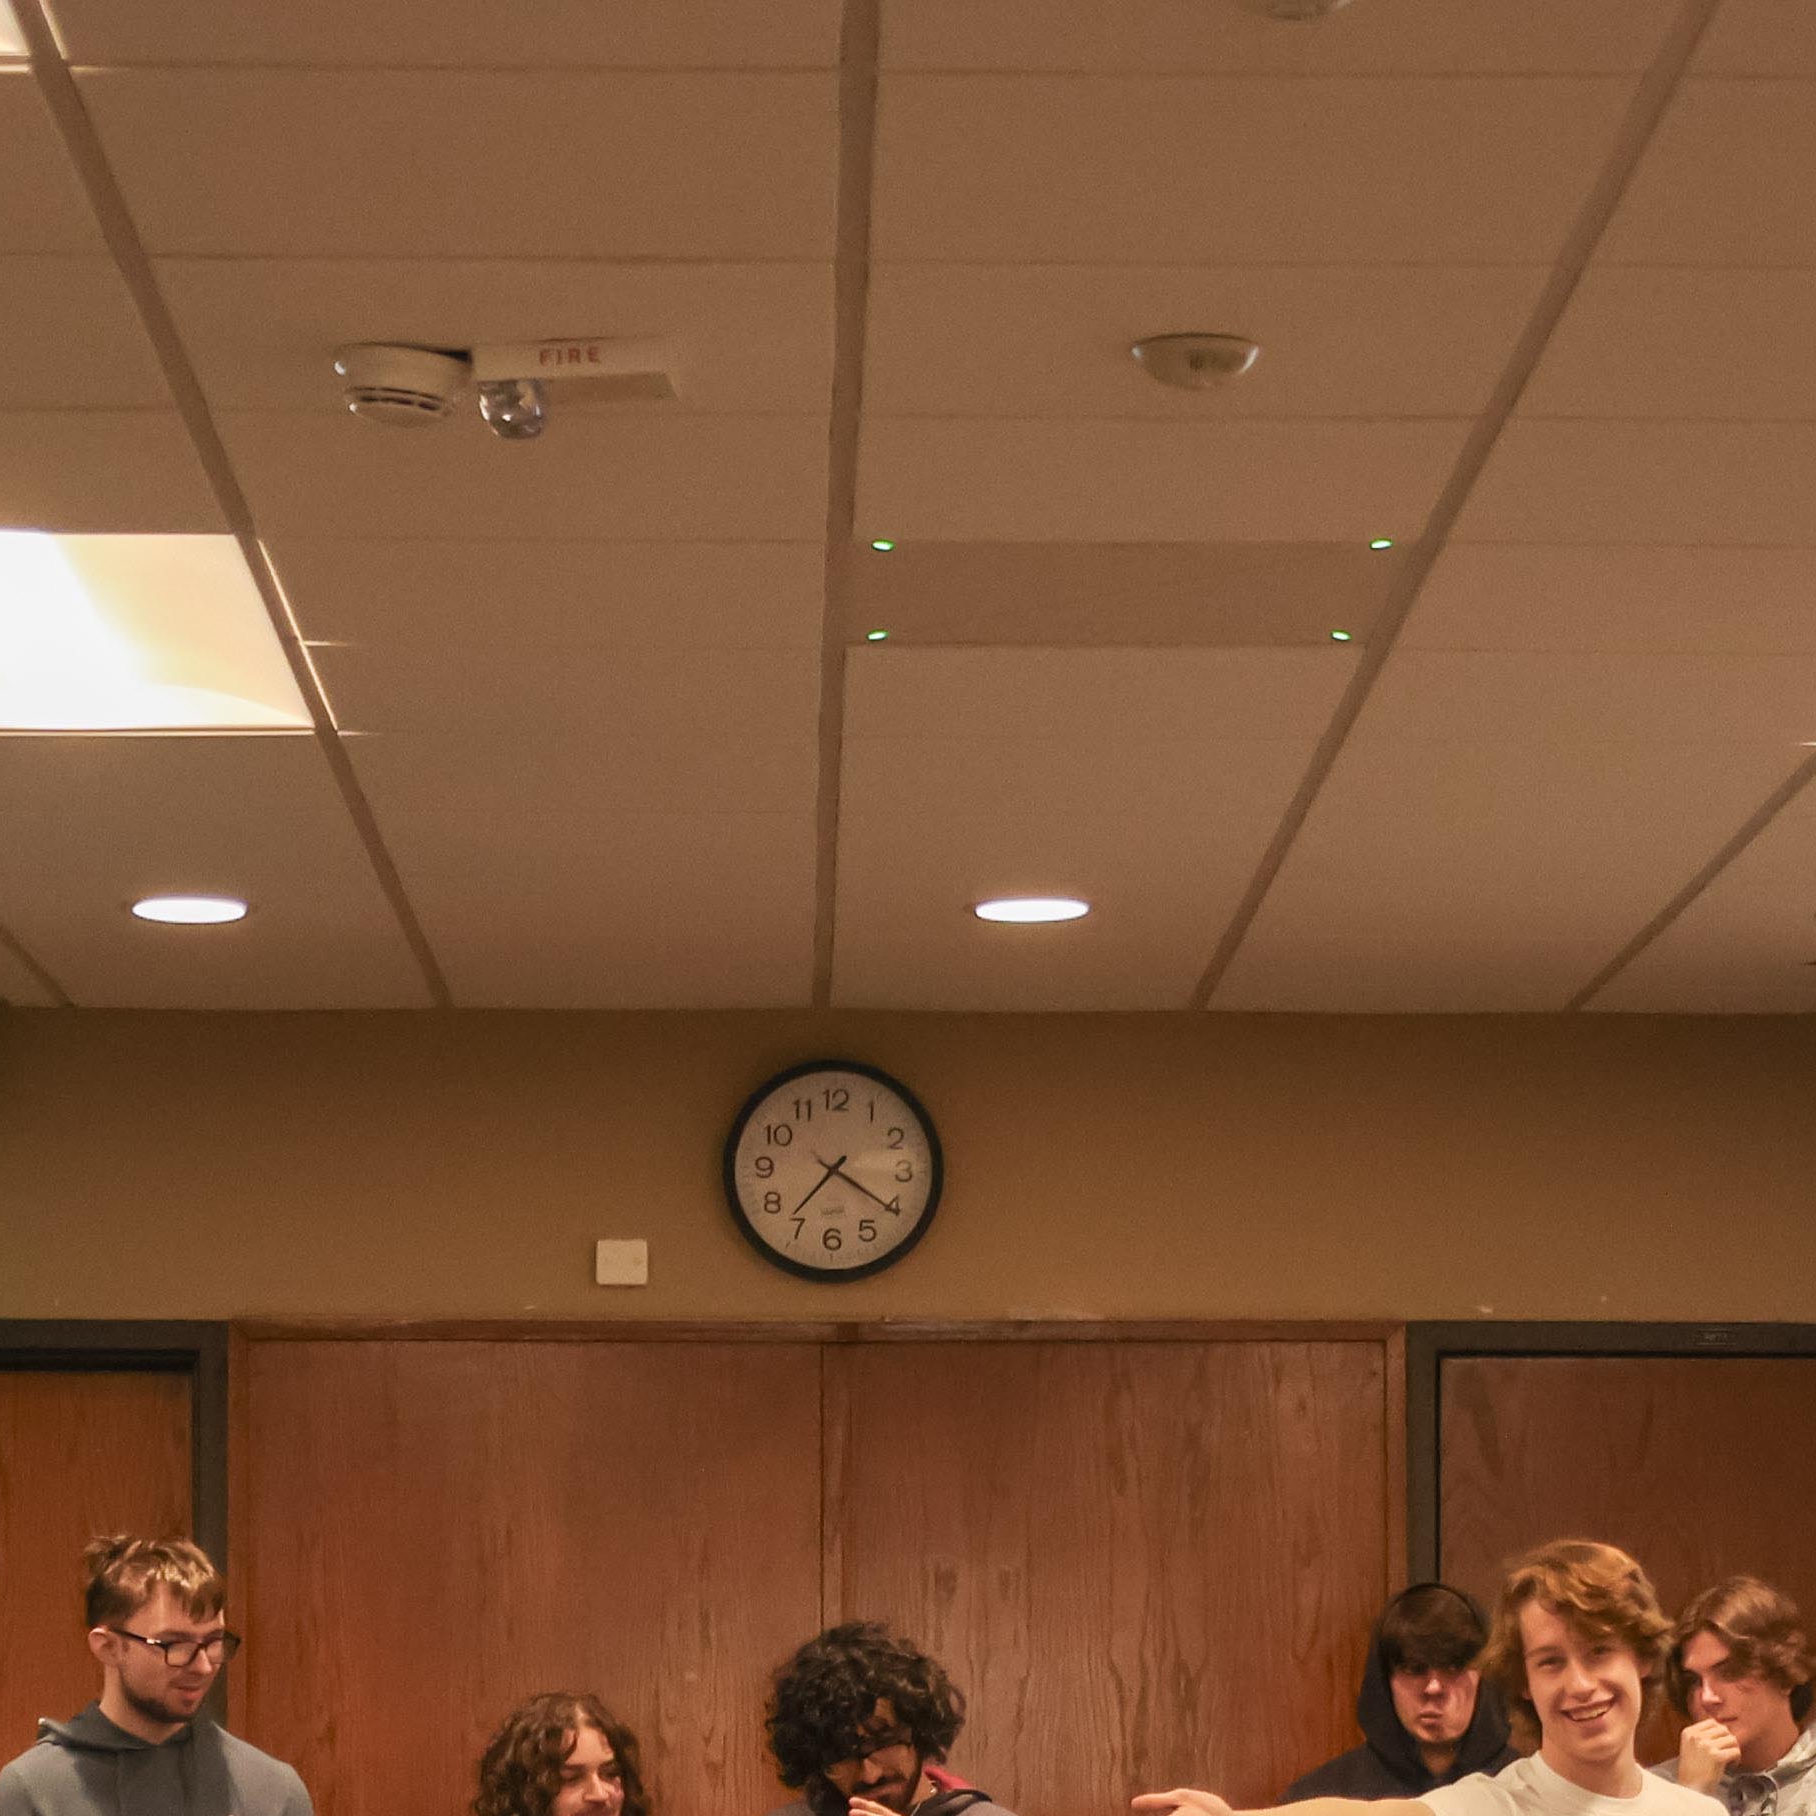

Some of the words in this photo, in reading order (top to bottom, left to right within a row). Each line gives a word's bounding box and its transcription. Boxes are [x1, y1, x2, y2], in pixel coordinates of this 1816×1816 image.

[538, 347, 602, 366] FIRE
[793, 1099, 812, 1122] 11
[822, 1088, 849, 1111] 12
[868, 1101, 875, 1123] 1
[765, 1124, 793, 1147] 10
[887, 1127, 905, 1150] 2
[755, 1156, 774, 1178] 9
[895, 1159, 913, 1182] 3
[764, 1191, 781, 1214] 8
[885, 1195, 901, 1216] 4
[790, 1218, 806, 1240] 7
[822, 1228, 842, 1251] 6
[858, 1219, 877, 1242] 5
